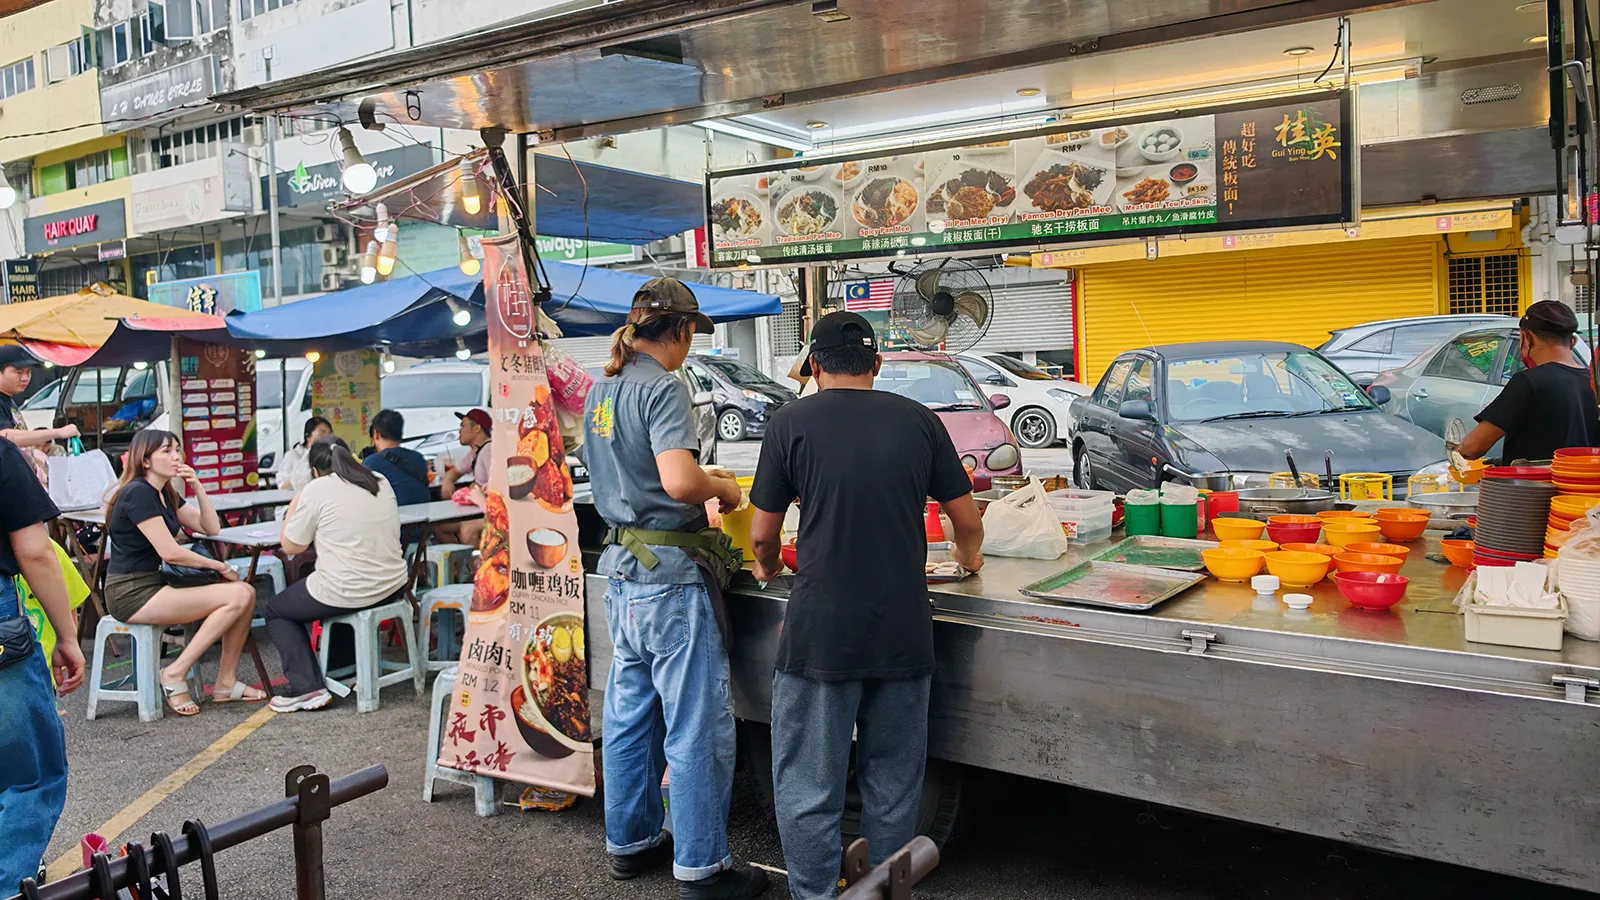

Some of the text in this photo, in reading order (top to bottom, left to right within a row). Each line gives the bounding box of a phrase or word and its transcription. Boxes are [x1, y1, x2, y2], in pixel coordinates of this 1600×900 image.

[133, 88, 165, 110] DANCE
[167, 77, 203, 102] CIRCLE
[1274, 110, 1341, 160] 桂英
[1241, 121, 1257, 168] 超好吃
[1271, 147, 1306, 157] Gui Ying
[299, 173, 338, 194] Enliven
[1125, 203, 1142, 211] Meat
[1145, 202, 1160, 210] Ball
[1191, 198, 1209, 206] Skin
[954, 219, 970, 228] Pan
[970, 218, 988, 226] Mee
[988, 215, 1009, 225] (Dry)
[1022, 206, 1112, 221] Famous Dry Pan Mee
[44, 214, 97, 240] HAIR QUAY
[860, 225, 911, 238] Spicy Pan Mee
[716, 240, 734, 248] Hakka
[749, 238, 762, 246] Mee
[813, 232, 826, 240] Pan
[826, 232, 842, 240] Mee
[11, 284, 36, 295] HAIR
[511, 567, 580, 600] 咖喱鸡饭
[531, 593, 555, 604] CHICKEN
[556, 598, 569, 606] RICE
[510, 600, 540, 620] RM 11
[461, 673, 499, 693] RM 12
[448, 704, 507, 747] 夜市
